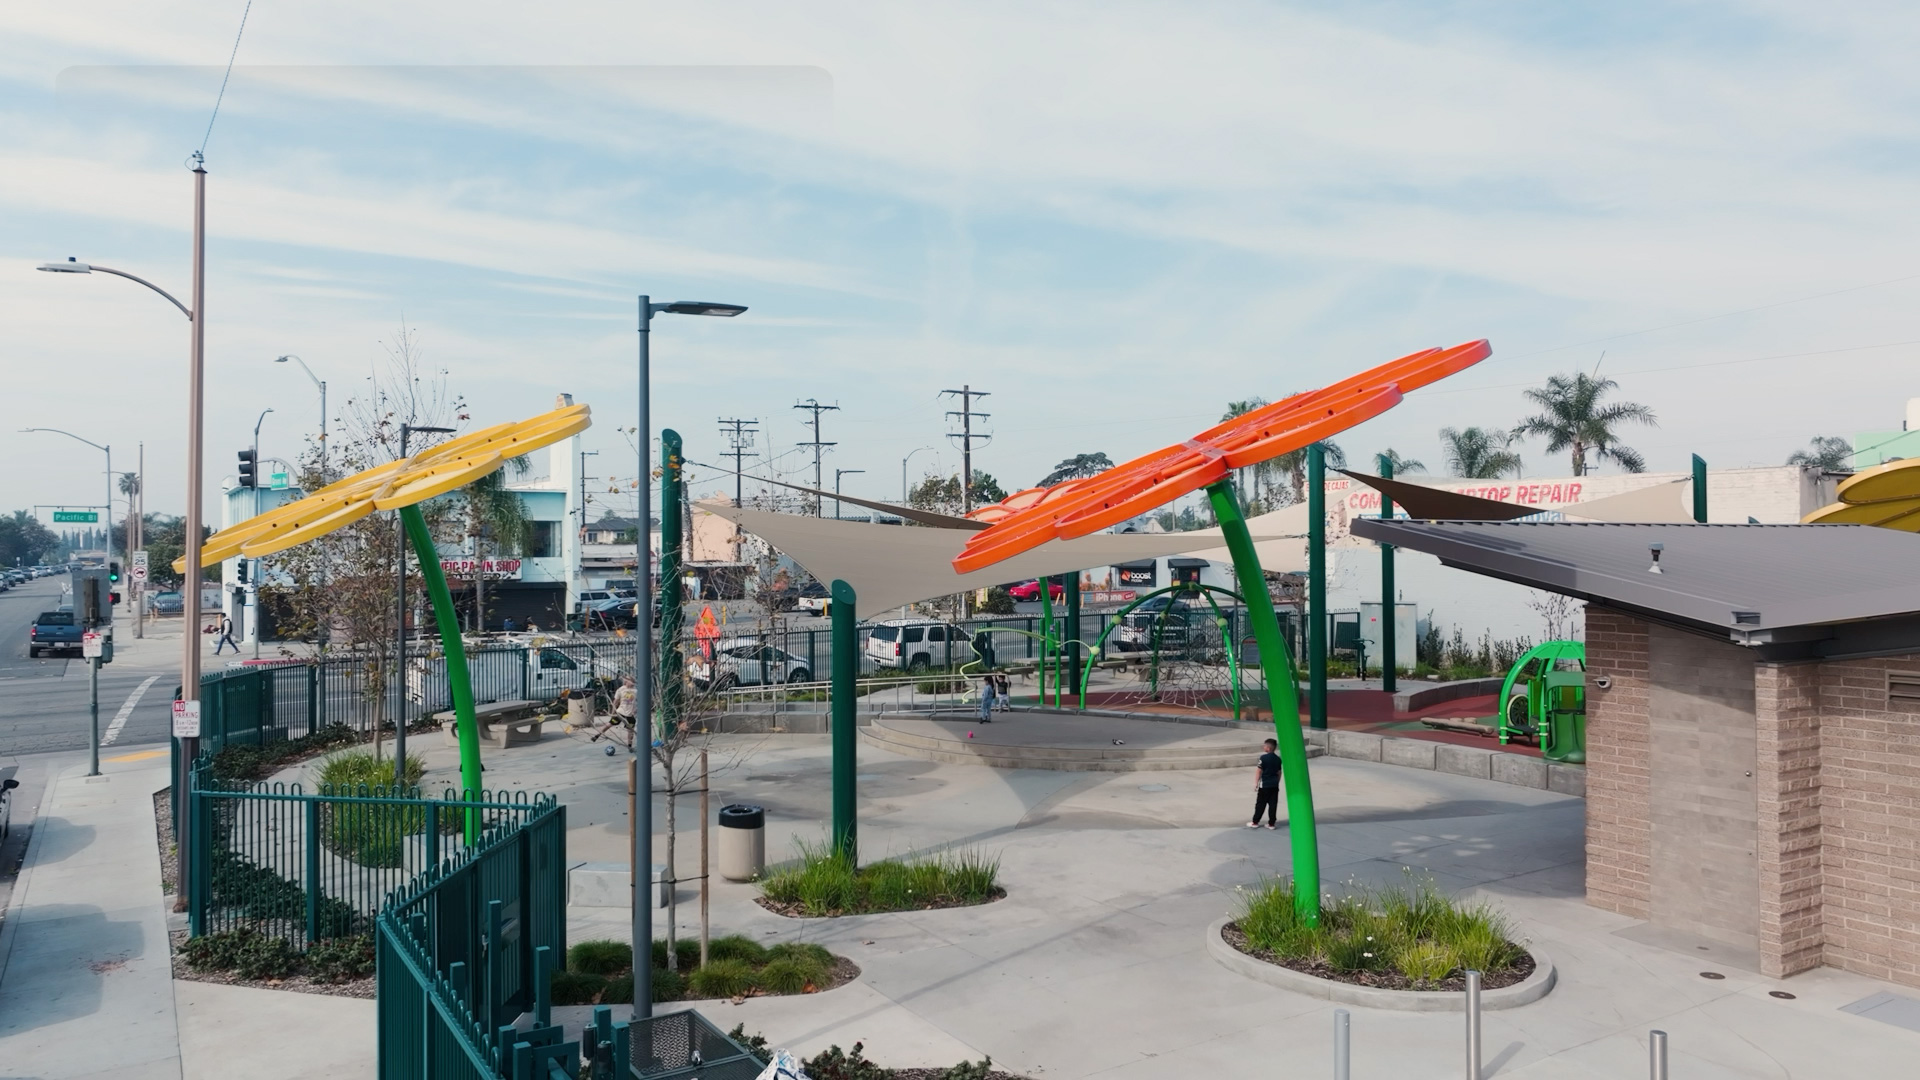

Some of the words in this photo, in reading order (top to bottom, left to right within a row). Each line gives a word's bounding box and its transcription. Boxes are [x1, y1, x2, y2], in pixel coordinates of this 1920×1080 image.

[1331, 481, 1349, 490] CAJAS
[1515, 483, 1582, 504] REPAIR
[134, 558, 146, 566] 25
[496, 560, 521, 573] SHOP
[1131, 572, 1152, 580] boost
[175, 702, 185, 710] NO
